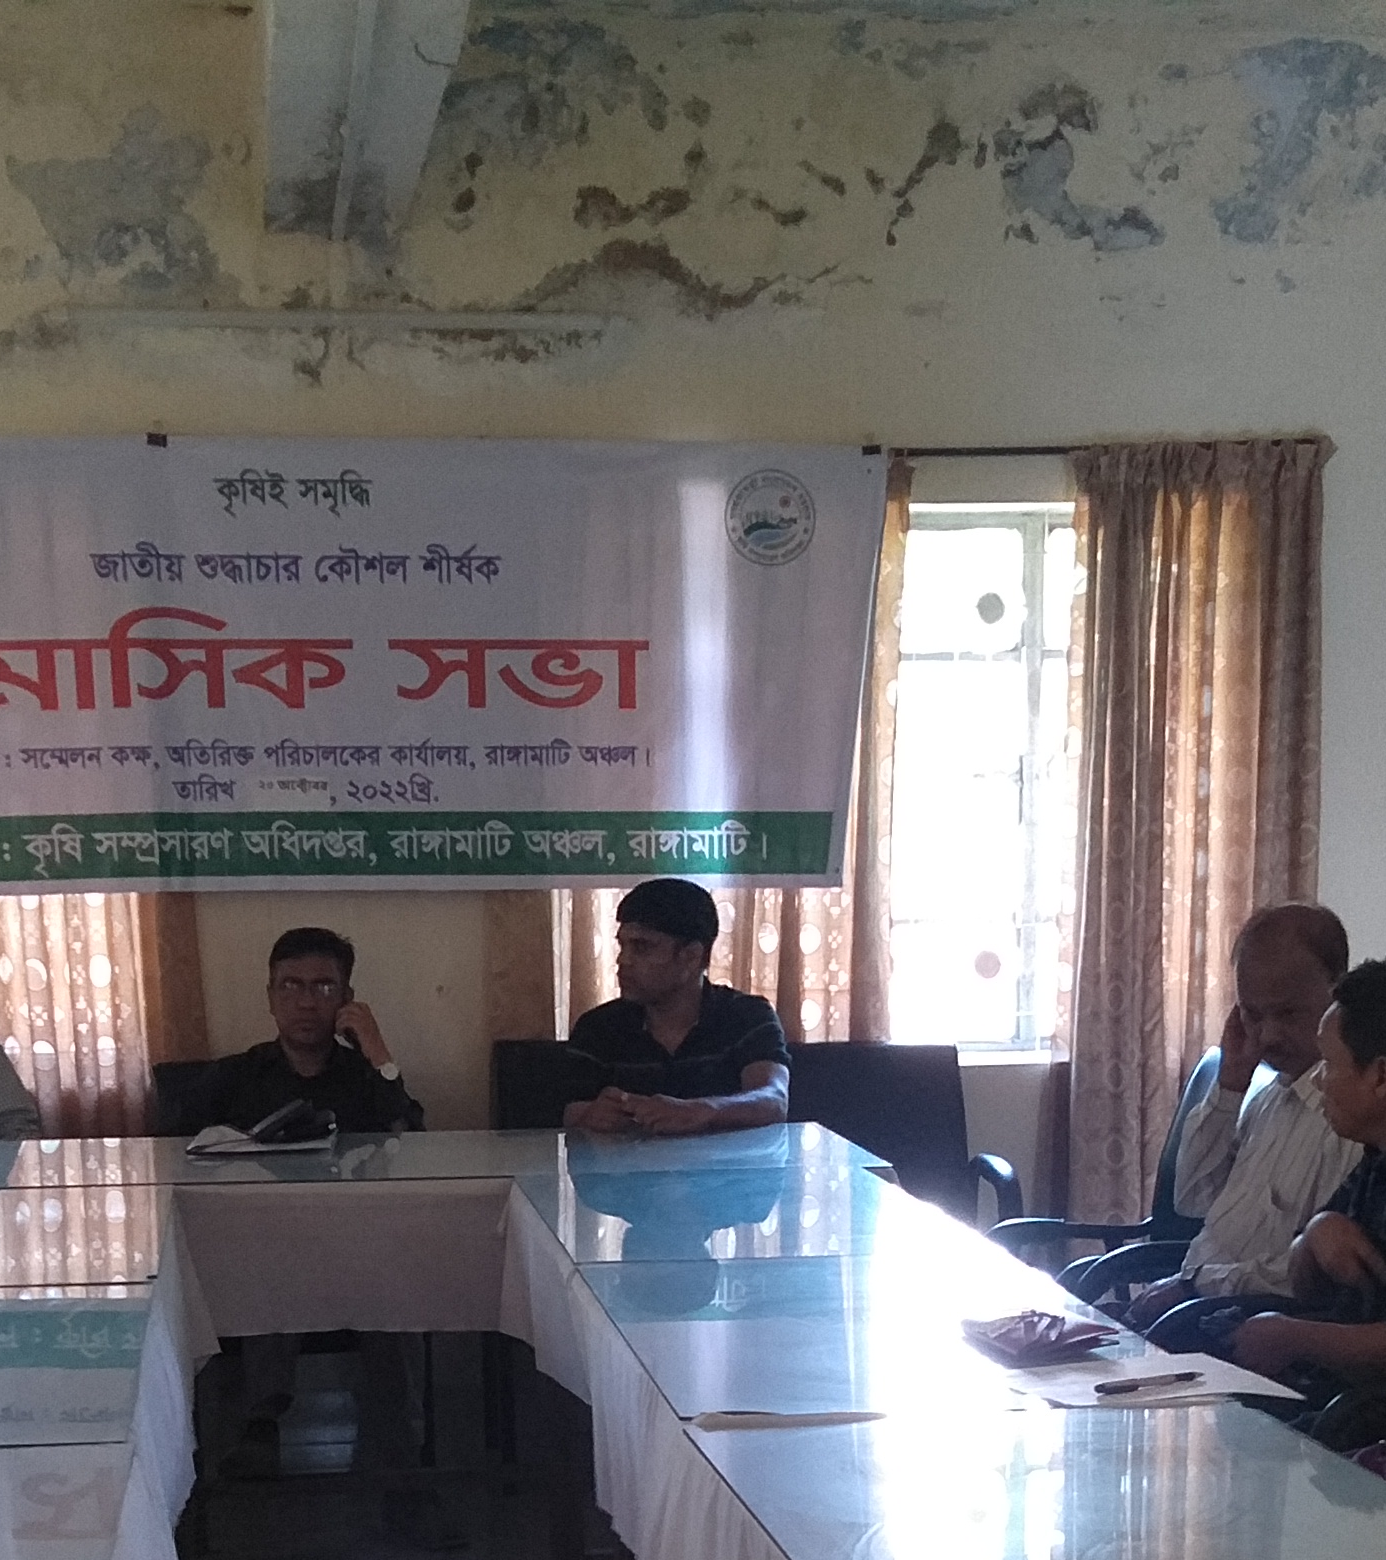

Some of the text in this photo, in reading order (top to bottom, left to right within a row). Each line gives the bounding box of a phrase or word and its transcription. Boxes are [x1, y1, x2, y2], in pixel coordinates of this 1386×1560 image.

[212, 468, 373, 518] কৃষিই সমৃদ্ধি
[88, 540, 503, 586] জাতীয় শুদ্ধাচার কৌশল শীর্ষক
[388, 639, 650, 710] সভা
[18, 746, 104, 770] সম্মেলন
[107, 745, 161, 771] কক্ষ,
[163, 737, 256, 768] অতিরিক্ত
[263, 737, 383, 768] পরিচালকের
[387, 737, 476, 771] কার্যালয়,
[483, 737, 573, 767] রাঙ্গামাটি
[577, 745, 639, 768] অঞ্চল
[171, 773, 237, 802] তারিখ
[21, 822, 85, 879] কৃষি
[90, 827, 234, 866] সম্প্রসারণ
[240, 819, 378, 867] অধিদপ্তর,
[387, 819, 515, 860] রাঙ্গামাটি
[522, 829, 616, 867] অঞ্চল,
[626, 819, 753, 861] রাঙ্গামাটি
